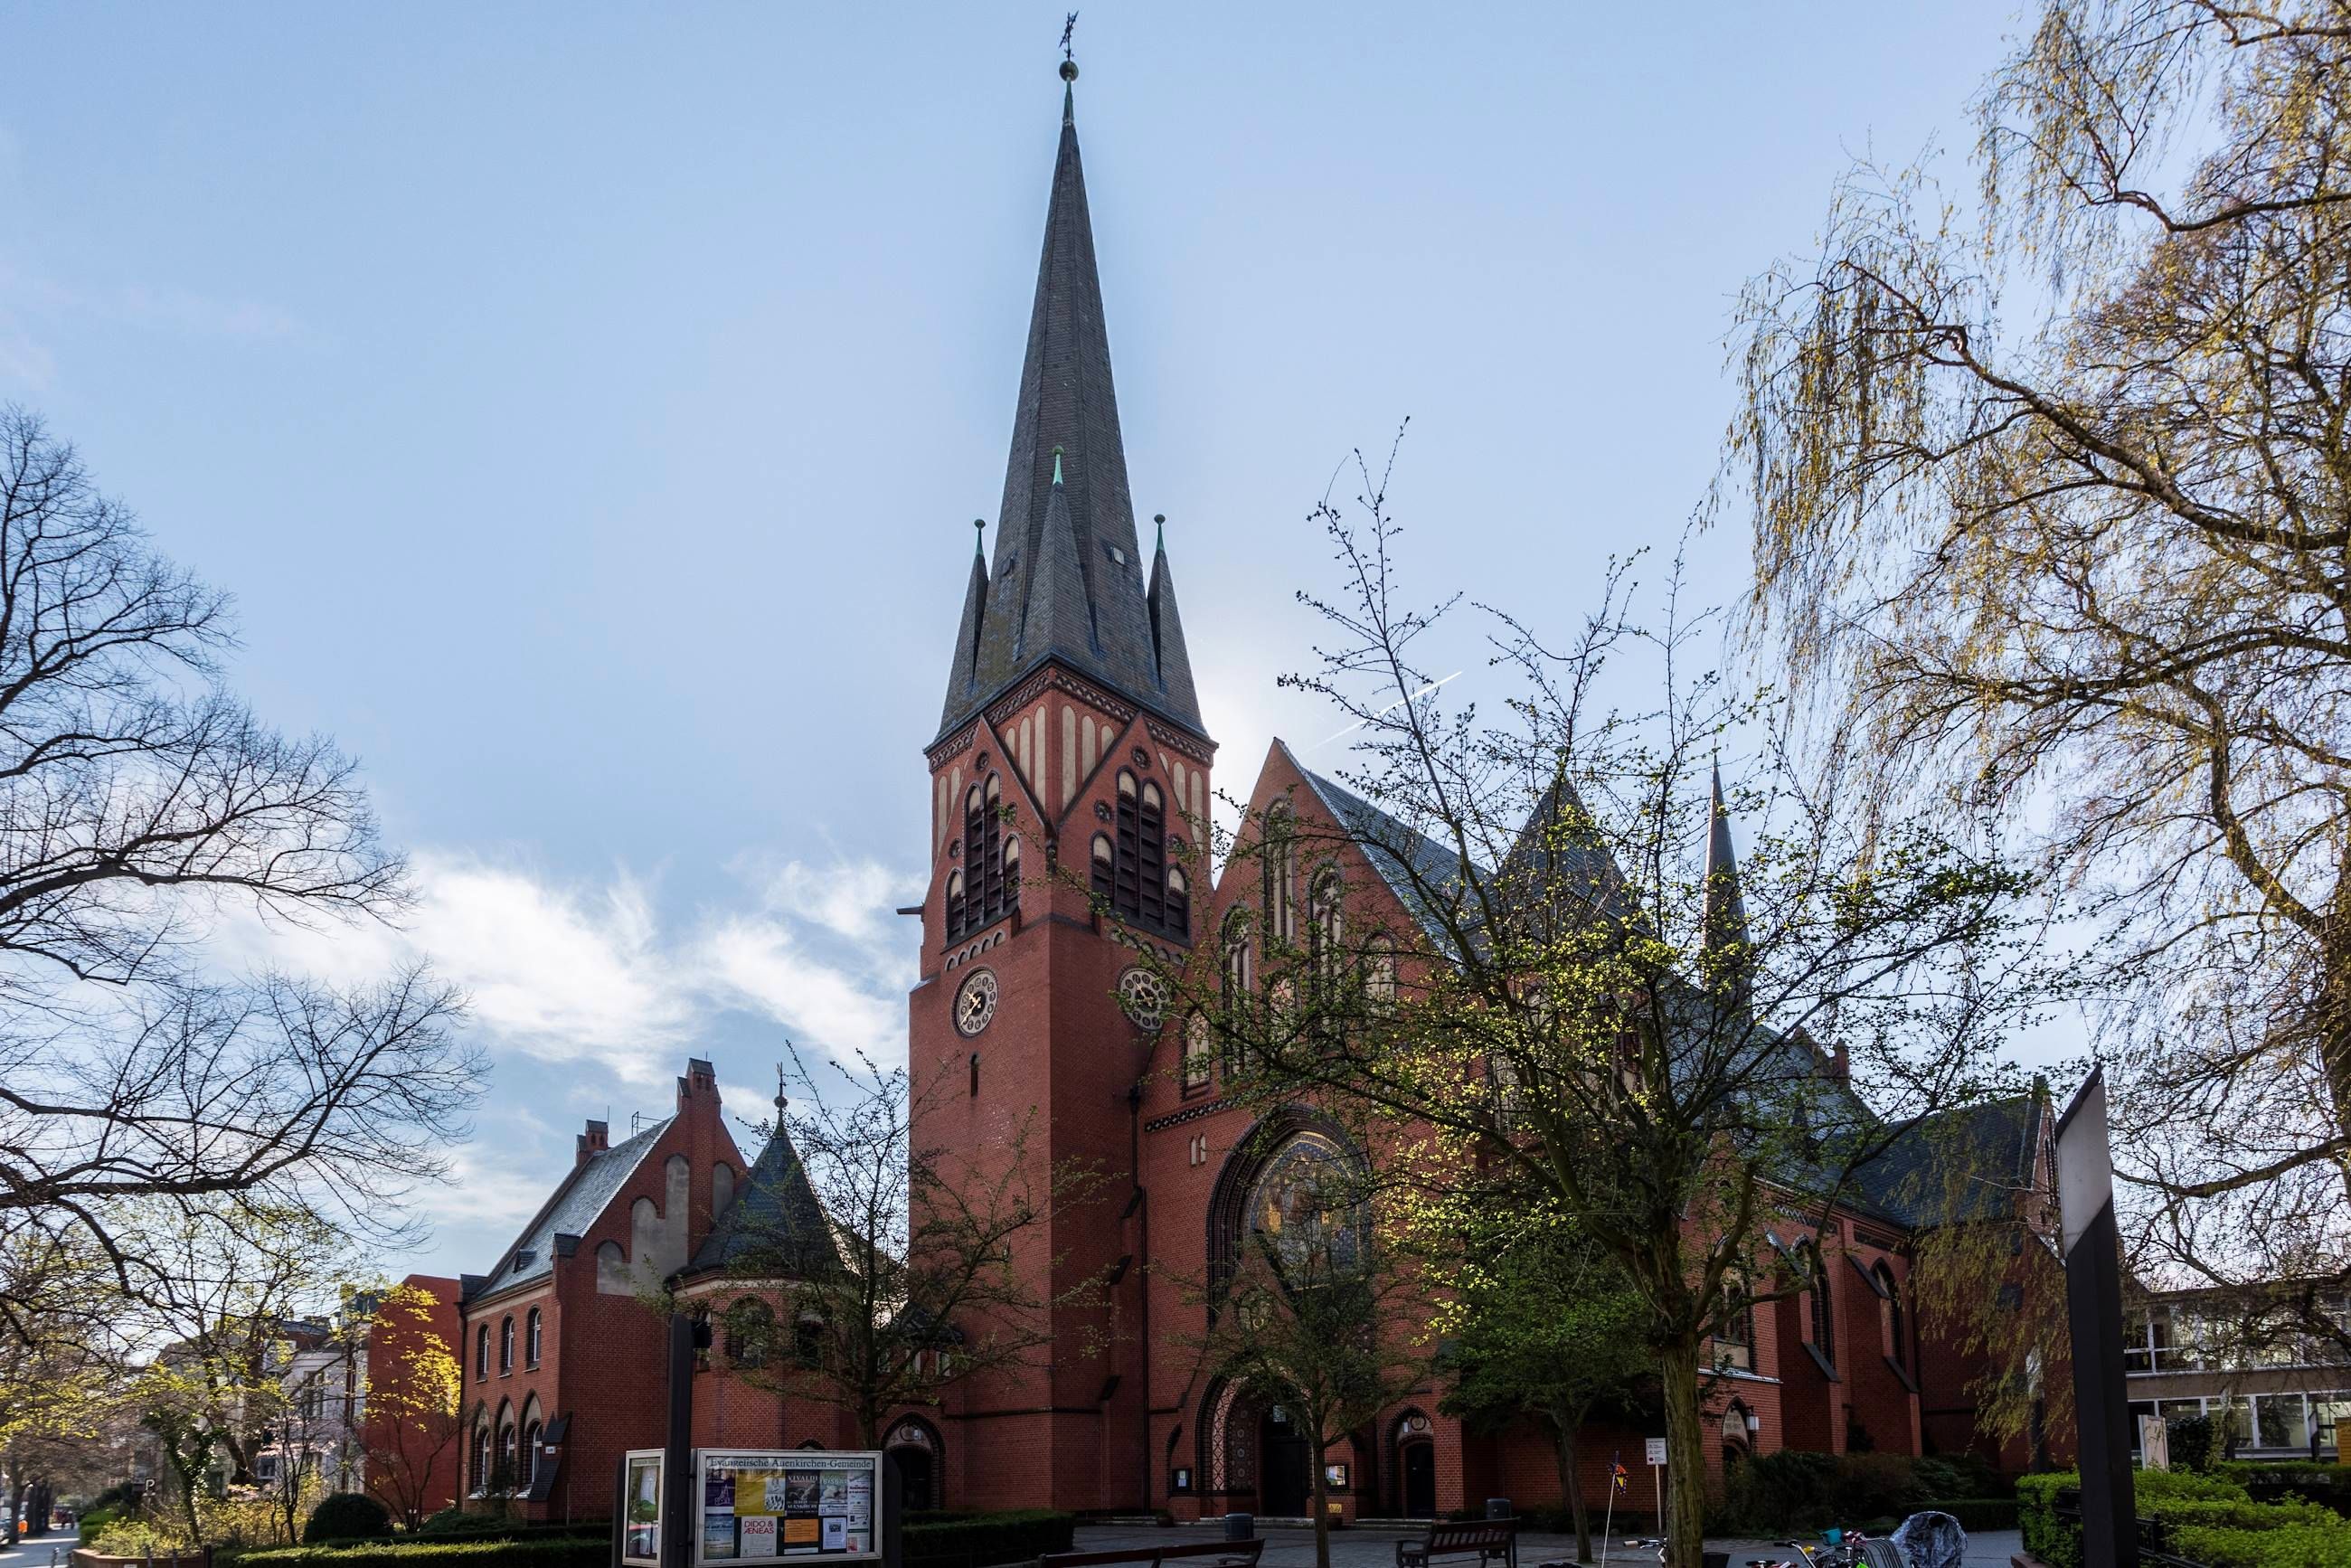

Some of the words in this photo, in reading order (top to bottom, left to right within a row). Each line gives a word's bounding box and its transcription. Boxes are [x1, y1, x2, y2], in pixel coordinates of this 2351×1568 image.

[710, 1458, 770, 1469] Evangelische
[772, 1458, 871, 1469] Auenkirchen-Gemeinde
[146, 1478, 155, 1490] P
[744, 1520, 766, 1528] DIDO
